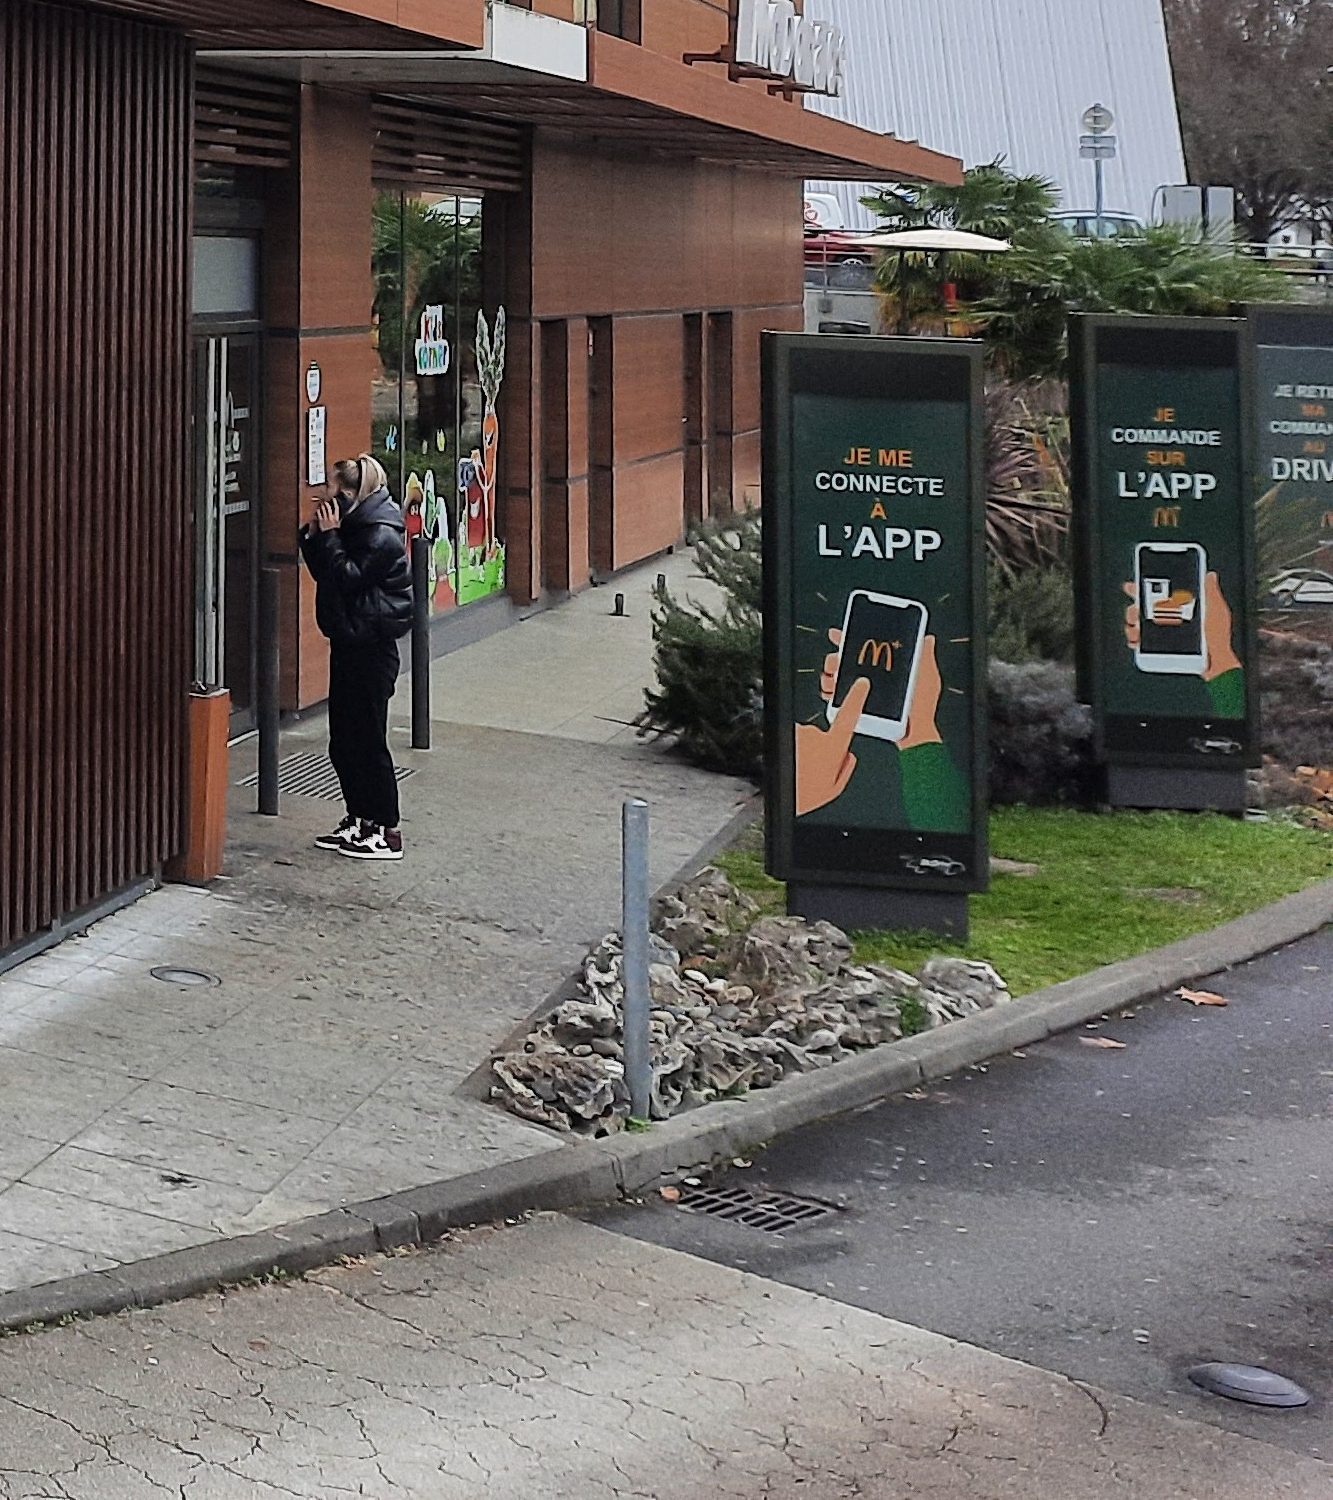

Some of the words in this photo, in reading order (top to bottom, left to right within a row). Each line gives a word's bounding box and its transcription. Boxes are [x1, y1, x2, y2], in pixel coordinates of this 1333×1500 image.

[1153, 407, 1175, 423] JE
[1112, 427, 1222, 446] COMMANDE
[844, 447, 872, 466] JE
[878, 448, 913, 469] ME
[1147, 450, 1186, 467] SUR
[815, 471, 945, 497] CONNECTE
[1118, 470, 1217, 501] L'APP
[870, 496, 887, 521] À
[818, 523, 943, 562] L'APP
